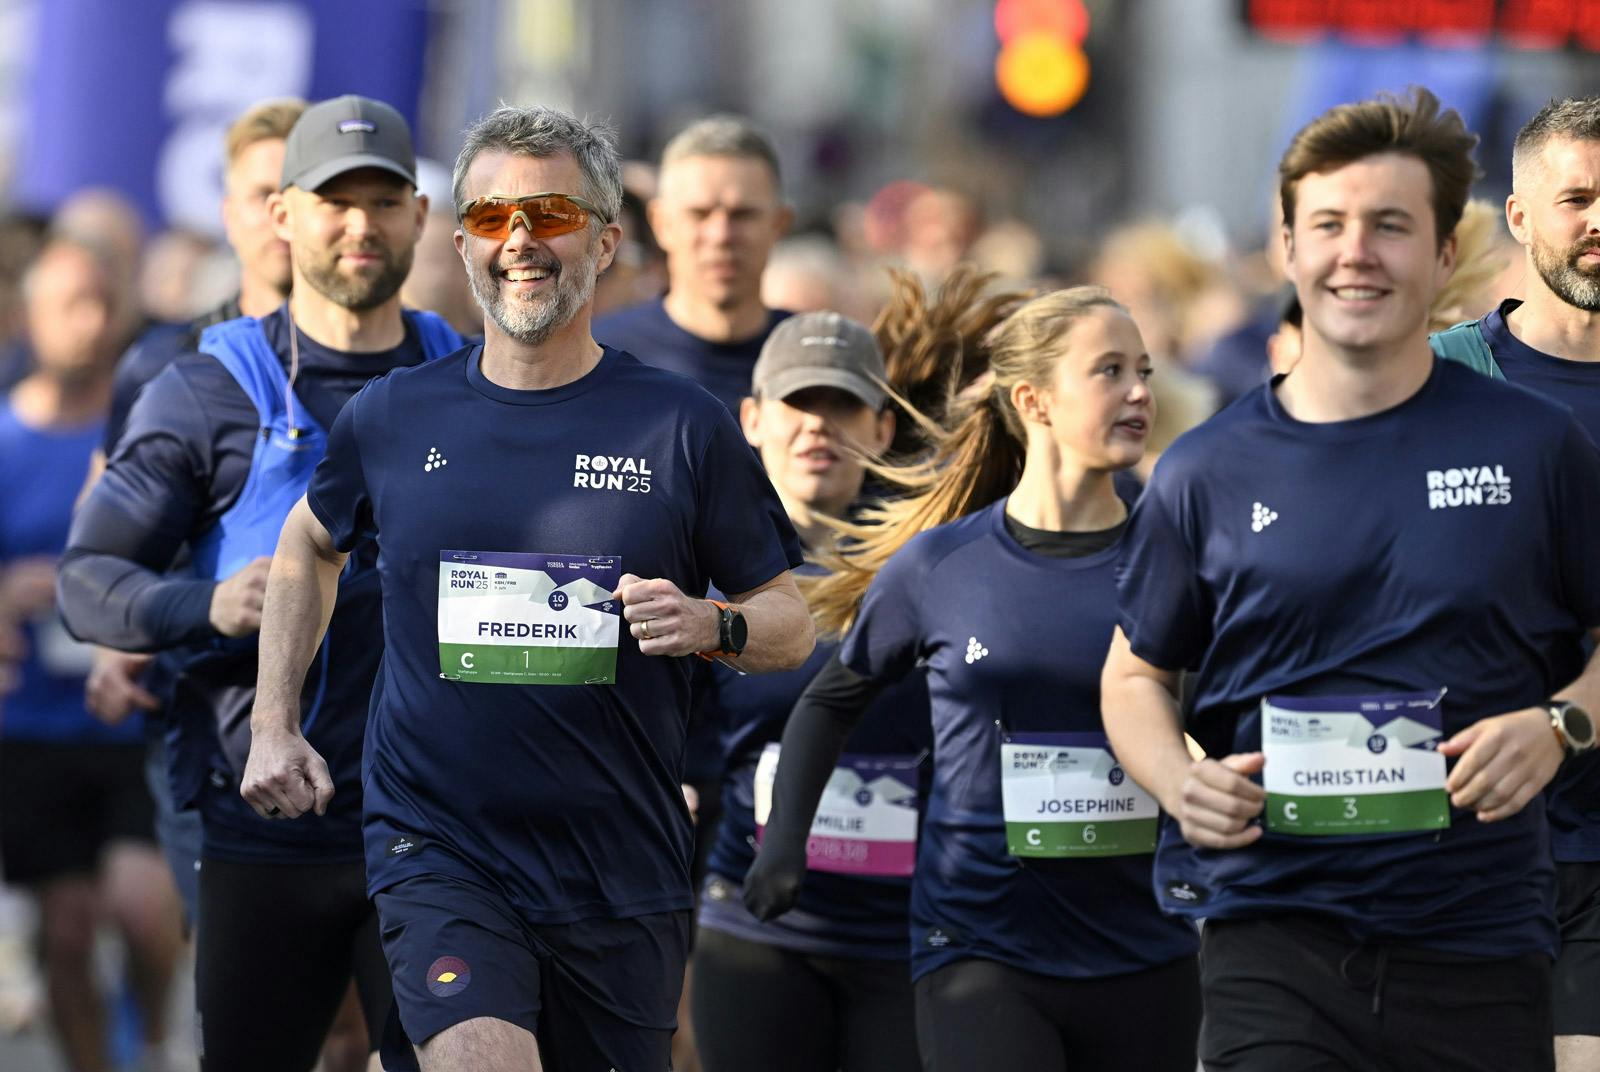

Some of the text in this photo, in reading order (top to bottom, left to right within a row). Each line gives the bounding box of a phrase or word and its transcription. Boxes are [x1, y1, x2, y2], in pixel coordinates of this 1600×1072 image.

[575, 454, 651, 475] ROYAL
[1427, 464, 1511, 490] ROYAL
[451, 570, 488, 580] ROYAL
[552, 594, 565, 603] 10
[478, 622, 578, 639] FREDERIK
[461, 650, 529, 669] C 1
[1293, 768, 1406, 786] CHRISTIAN
[1037, 798, 1136, 814] JOSEPHINE
[1284, 797, 1358, 820] C 3
[813, 815, 865, 833] MILIE
[1026, 824, 1097, 846] C 6
